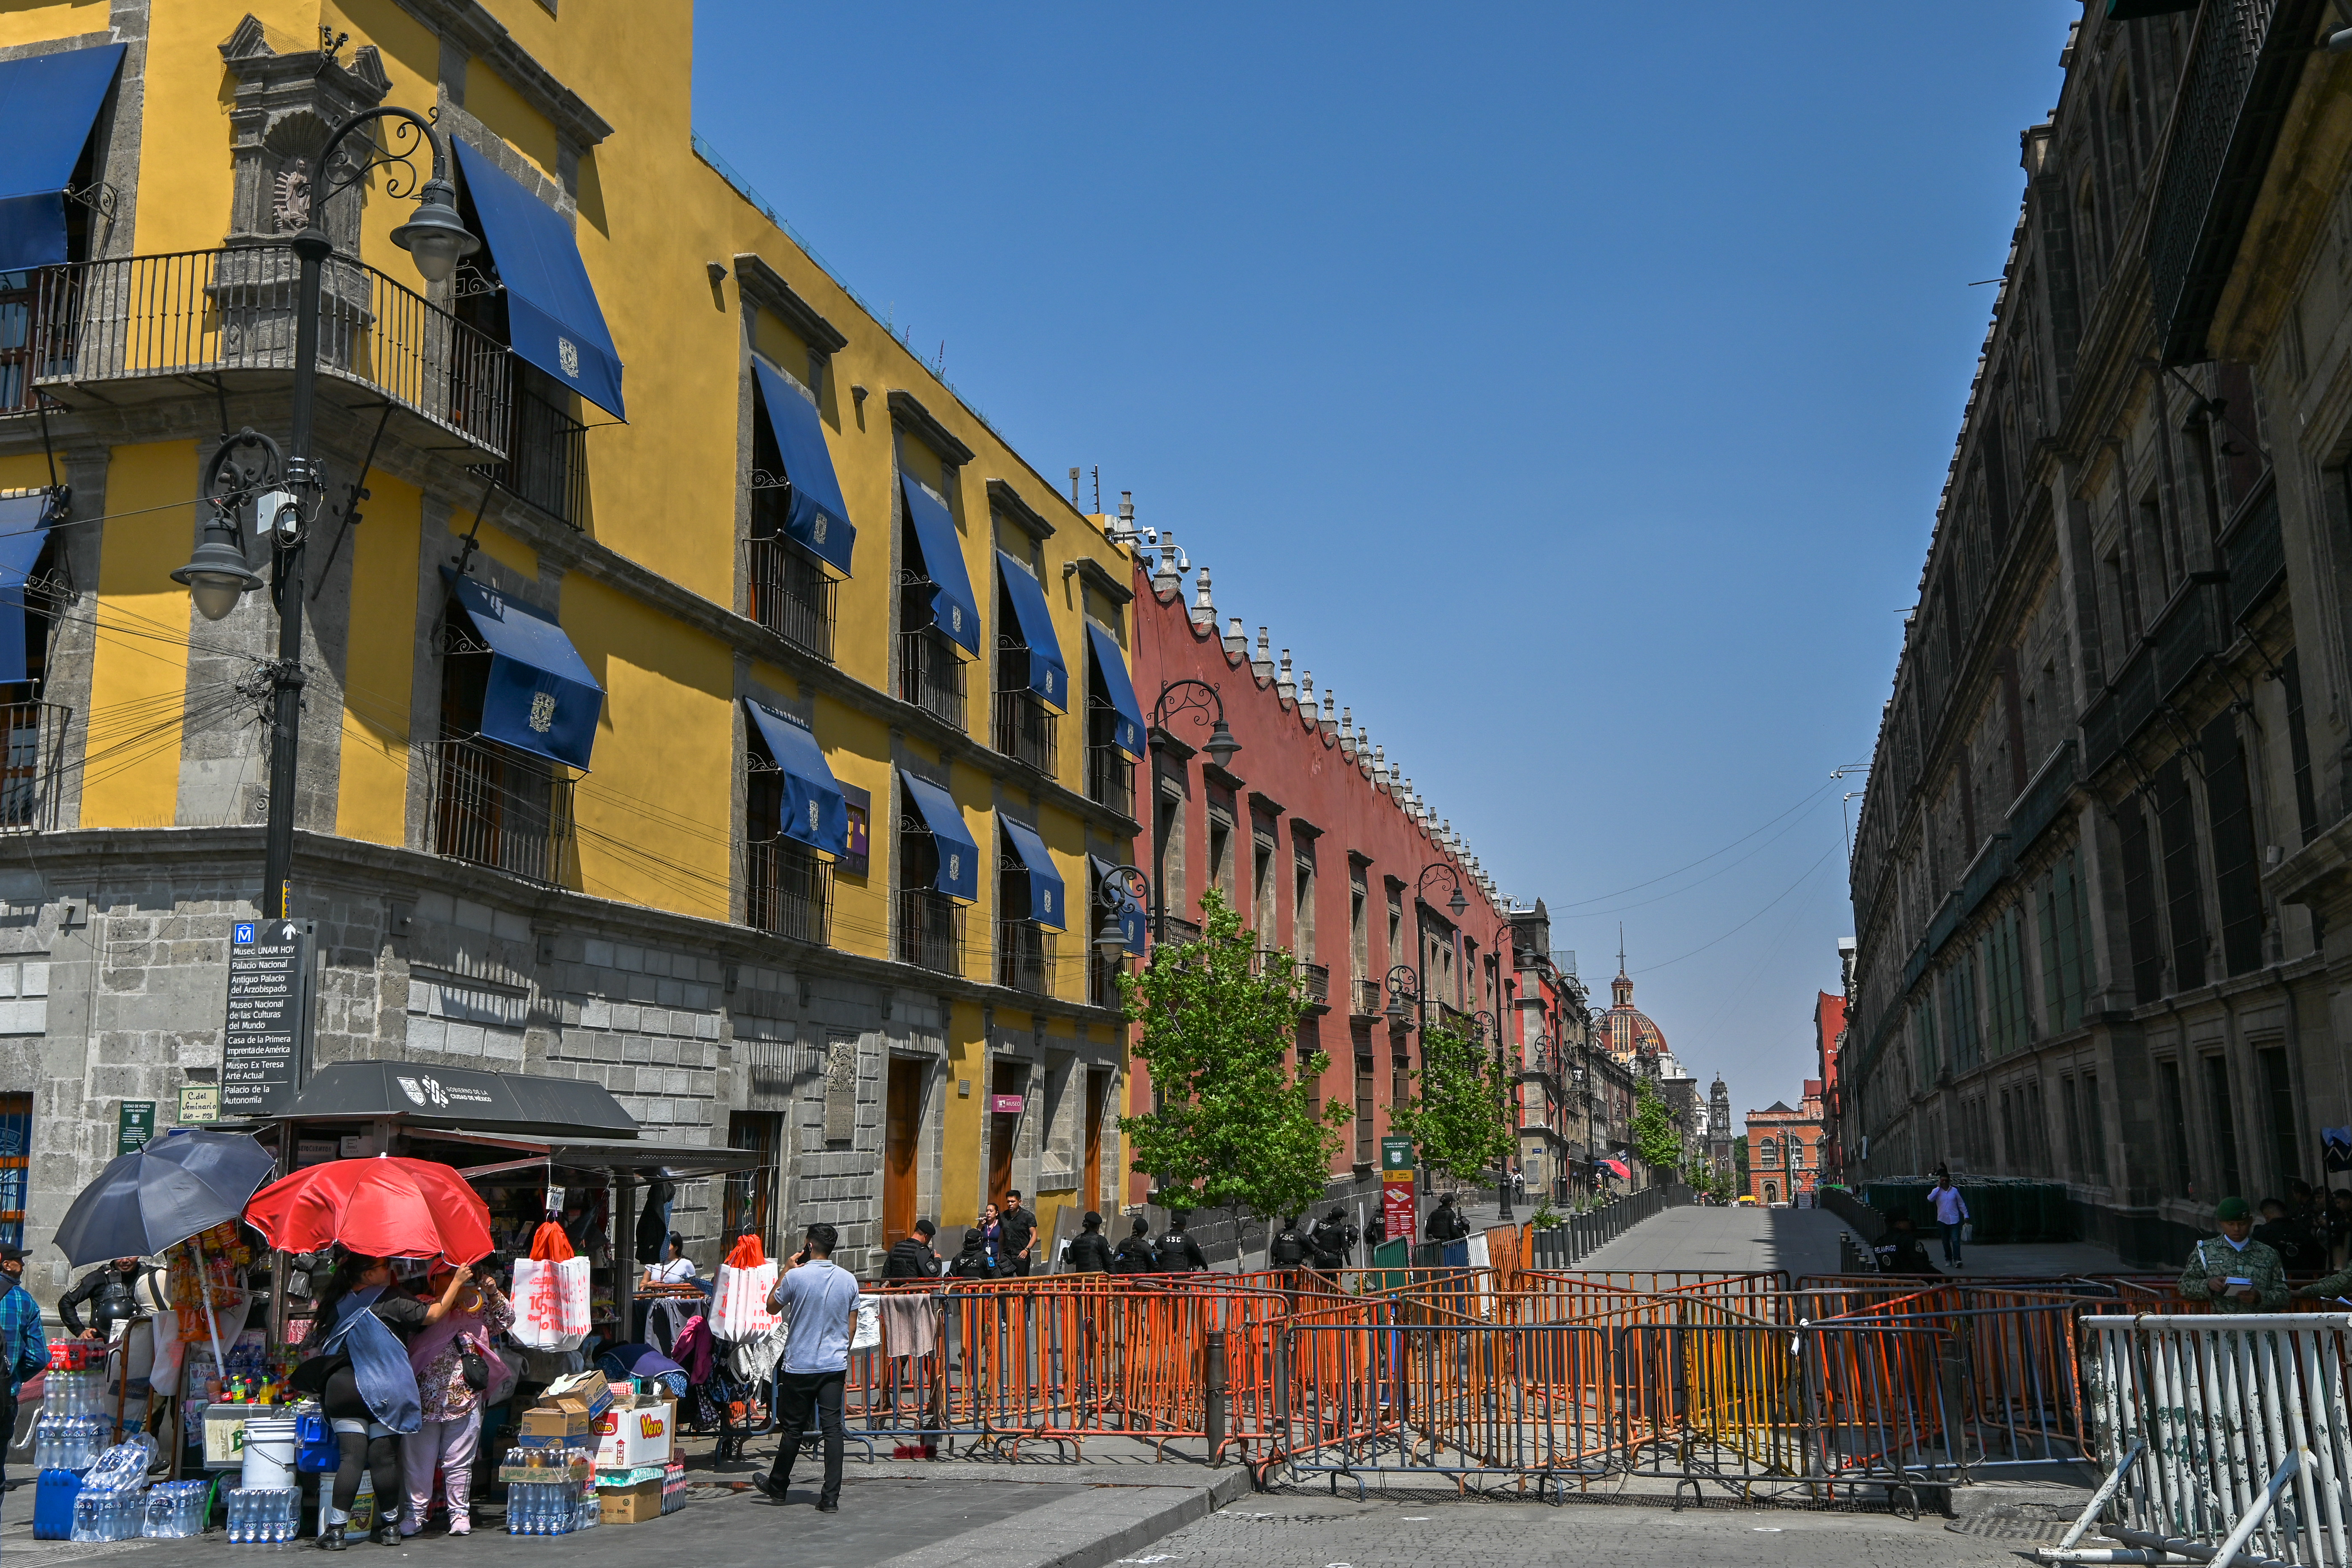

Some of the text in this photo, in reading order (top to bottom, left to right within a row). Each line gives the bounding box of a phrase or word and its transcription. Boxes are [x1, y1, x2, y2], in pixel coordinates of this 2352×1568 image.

[232, 959, 288, 969] Palacio Nacional
[231, 974, 285, 985] Antiguo Palacio
[231, 984, 287, 995] del Arzobispado
[255, 999, 283, 1008] Nacional
[229, 1010, 281, 1019] de las Culturas
[229, 1021, 265, 1029] del Mundo
[247, 1036, 256, 1044] de
[257, 1035, 263, 1043] la
[265, 1035, 291, 1043] Primera
[227, 1045, 290, 1056] Imprenta de América
[226, 1071, 264, 1080] Arte Actual
[225, 1084, 270, 1094] Palacio de la
[446, 1086, 472, 1094] GOBIERNO
[224, 1096, 262, 1105] Autonomía
[182, 1101, 216, 1111] Seminario
[2, 1130, 18, 1142] MXICO
[1874, 1244, 1896, 1253] RELAMPAGO
[596, 1423, 612, 1432] Vero
[642, 1417, 663, 1436] Vero
[504, 1469, 526, 1478] BOING!
